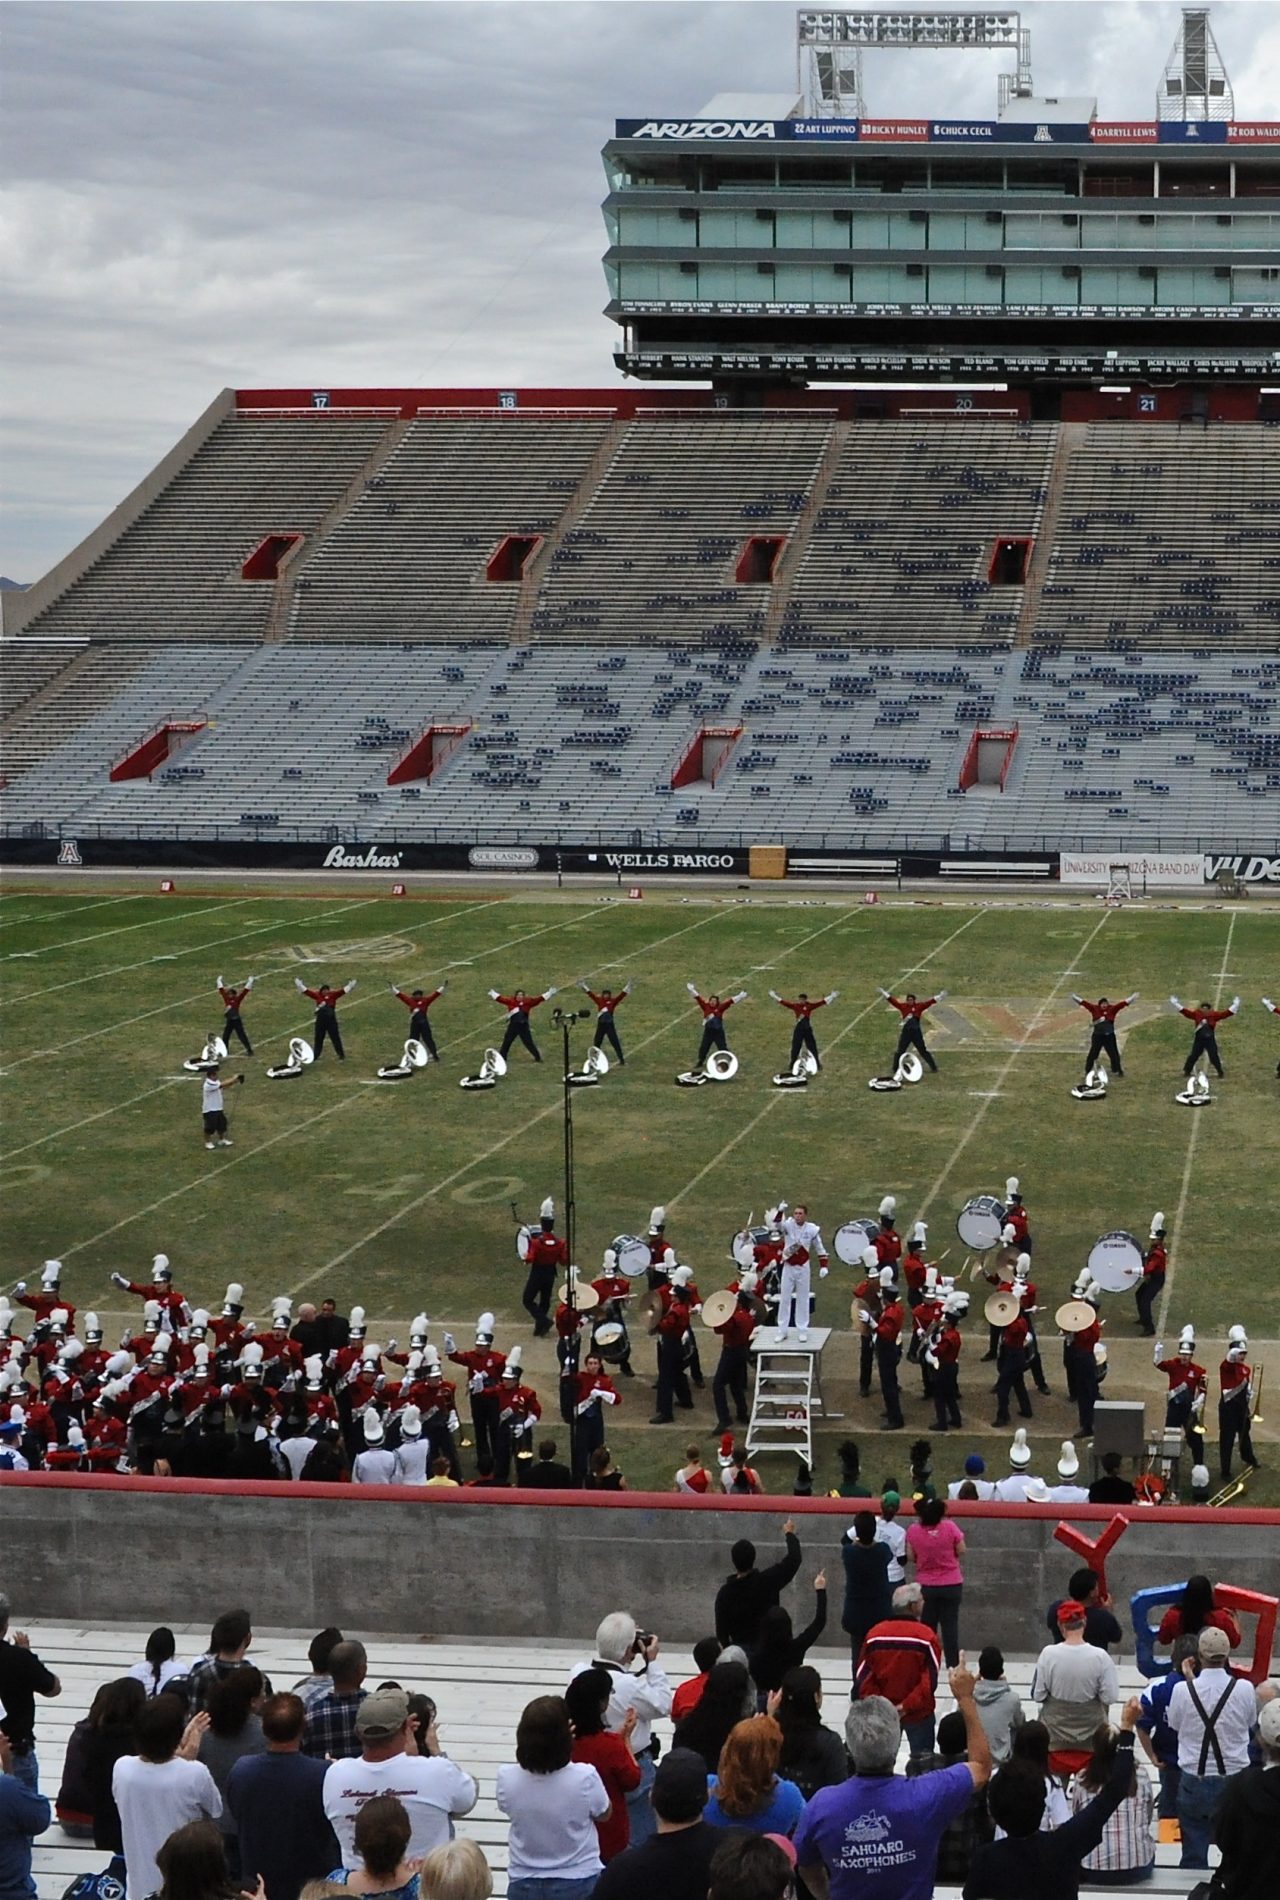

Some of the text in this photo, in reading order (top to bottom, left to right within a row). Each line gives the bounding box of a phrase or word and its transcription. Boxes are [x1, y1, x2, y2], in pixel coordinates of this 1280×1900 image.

[632, 122, 776, 139] ARIZONA
[794, 124, 856, 134] 22 ART LUPPINO
[872, 125, 895, 134] RICKY
[897, 126, 928, 135] HUNLEY
[940, 126, 969, 135] CHUCK
[970, 126, 993, 136] CECIL
[1090, 127, 1157, 137] 4 DARRYLL LEWIS
[314, 397, 327, 408] 17
[501, 397, 514, 408] 18
[1140, 399, 1154, 411] 21
[322, 845, 403, 868] Bashas'
[493, 853, 532, 861] CASINOS
[605, 854, 735, 868] WELLS FARGO
[1064, 862, 1107, 874] UNIVERSITY
[1159, 863, 1182, 875] BAND
[1183, 863, 1200, 875] DAY
[841, 1840, 904, 1858] SAHUARO
[832, 1849, 917, 1869] SAXOPHONES
